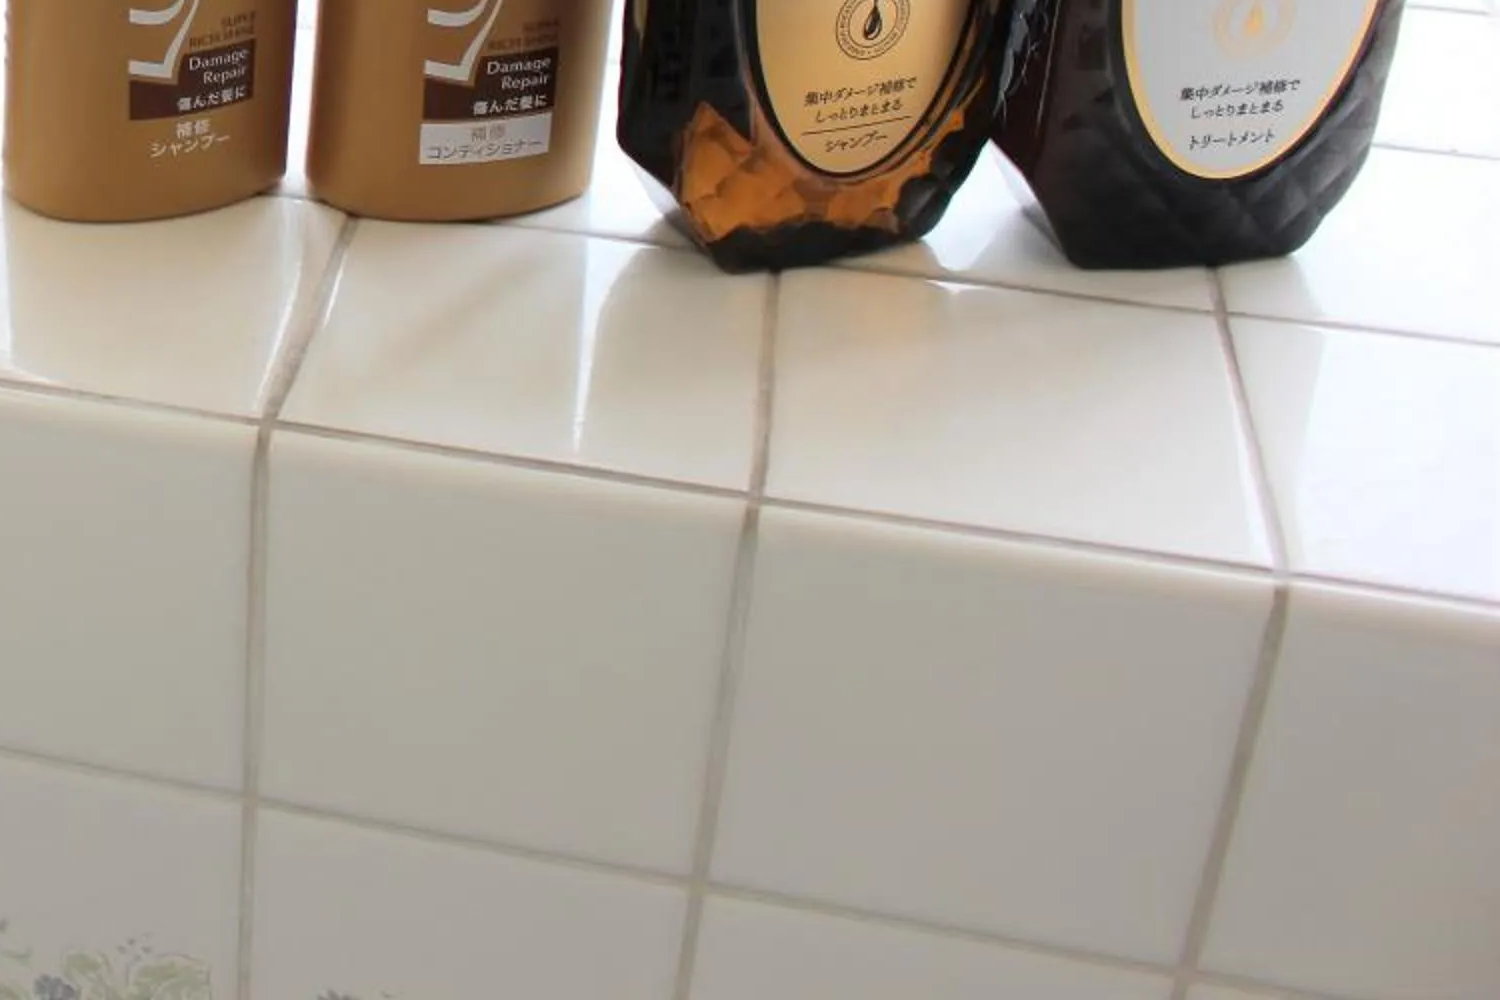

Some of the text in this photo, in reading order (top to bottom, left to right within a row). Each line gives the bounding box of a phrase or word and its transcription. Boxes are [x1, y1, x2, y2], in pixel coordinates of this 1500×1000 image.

[188, 47, 249, 71] Damage
[486, 56, 552, 76] Damage
[202, 65, 247, 85] Repair
[500, 72, 549, 91] Repair
[149, 134, 231, 159] シャンプー
[824, 129, 888, 153] シャンプー
[1188, 128, 1276, 152] トリートメント
